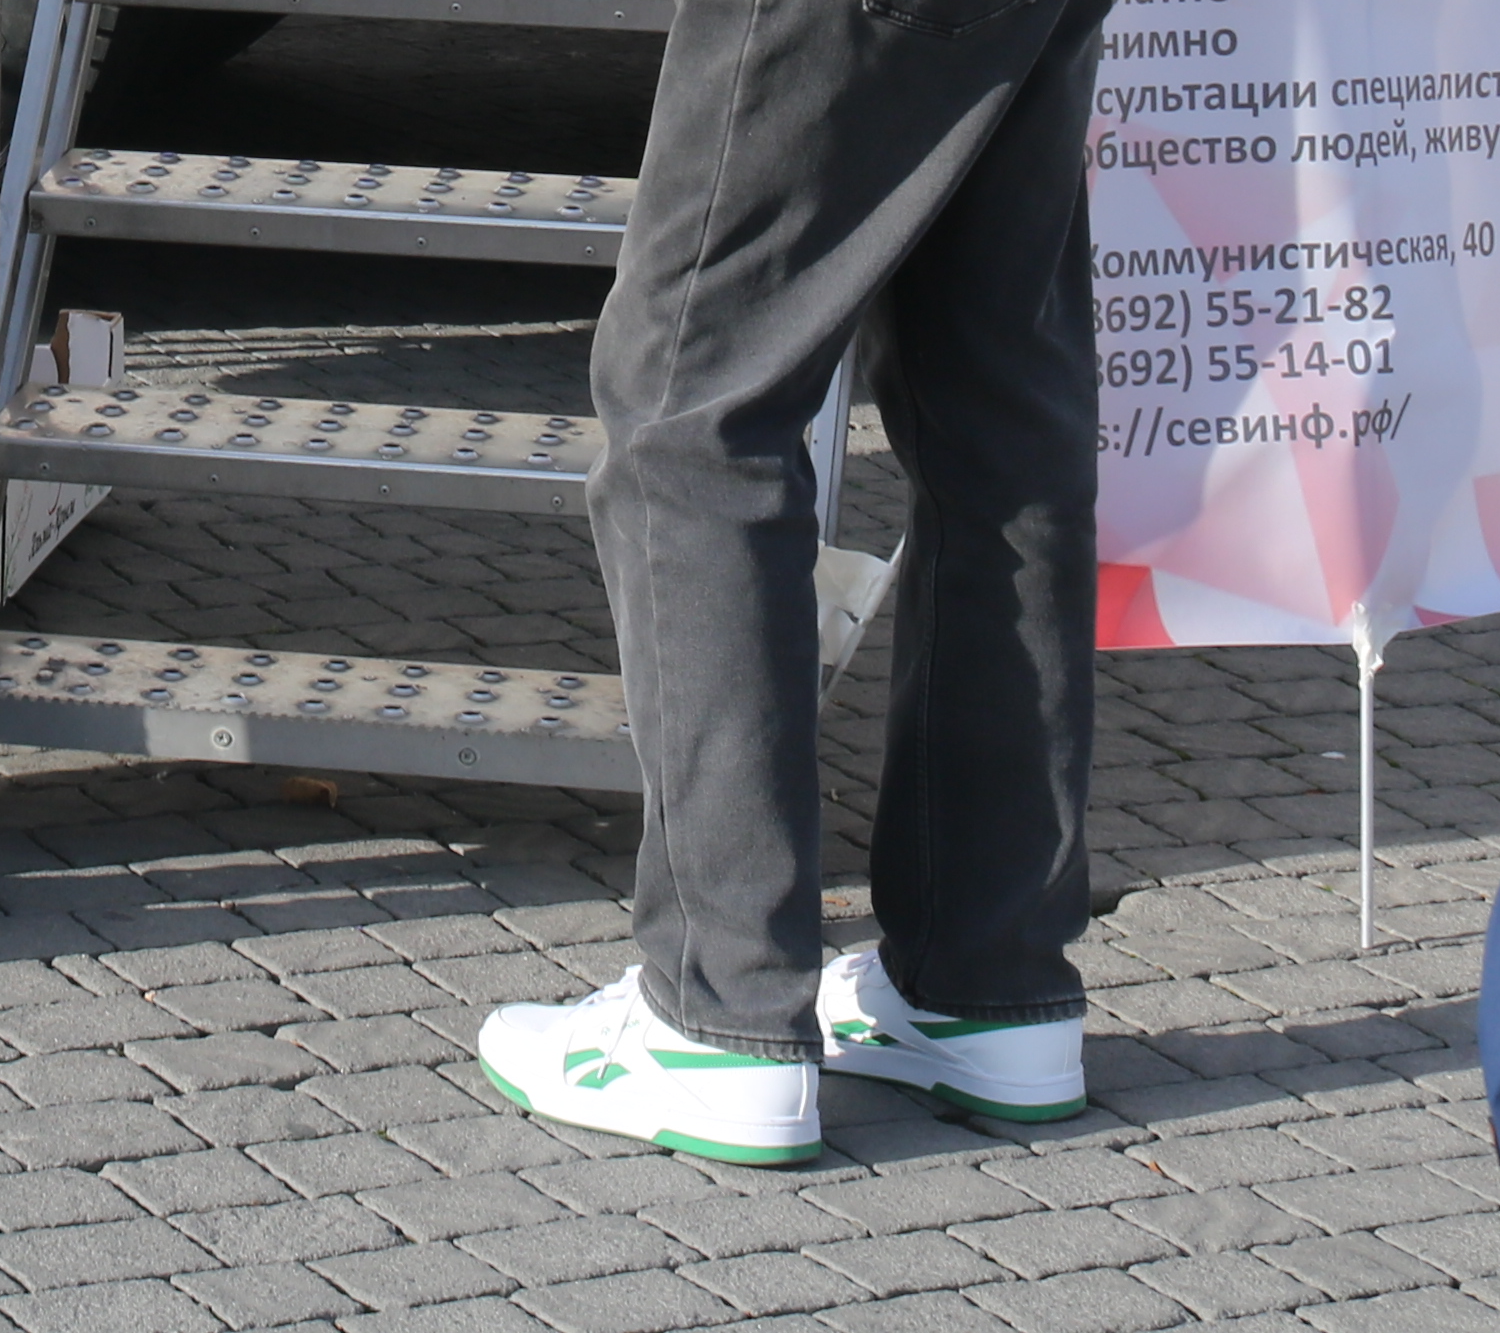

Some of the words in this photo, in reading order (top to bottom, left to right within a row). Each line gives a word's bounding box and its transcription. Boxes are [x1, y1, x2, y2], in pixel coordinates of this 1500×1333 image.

[1099, 28, 1238, 61] нимно
[1096, 81, 1318, 124] сультации
[1291, 118, 1417, 168] людей,
[1462, 220, 1496, 259] 40
[1206, 283, 1395, 328] 55-21-82
[1208, 338, 1395, 382] 55-14-01
[1097, 392, 1412, 458] s://севинф.рф/
